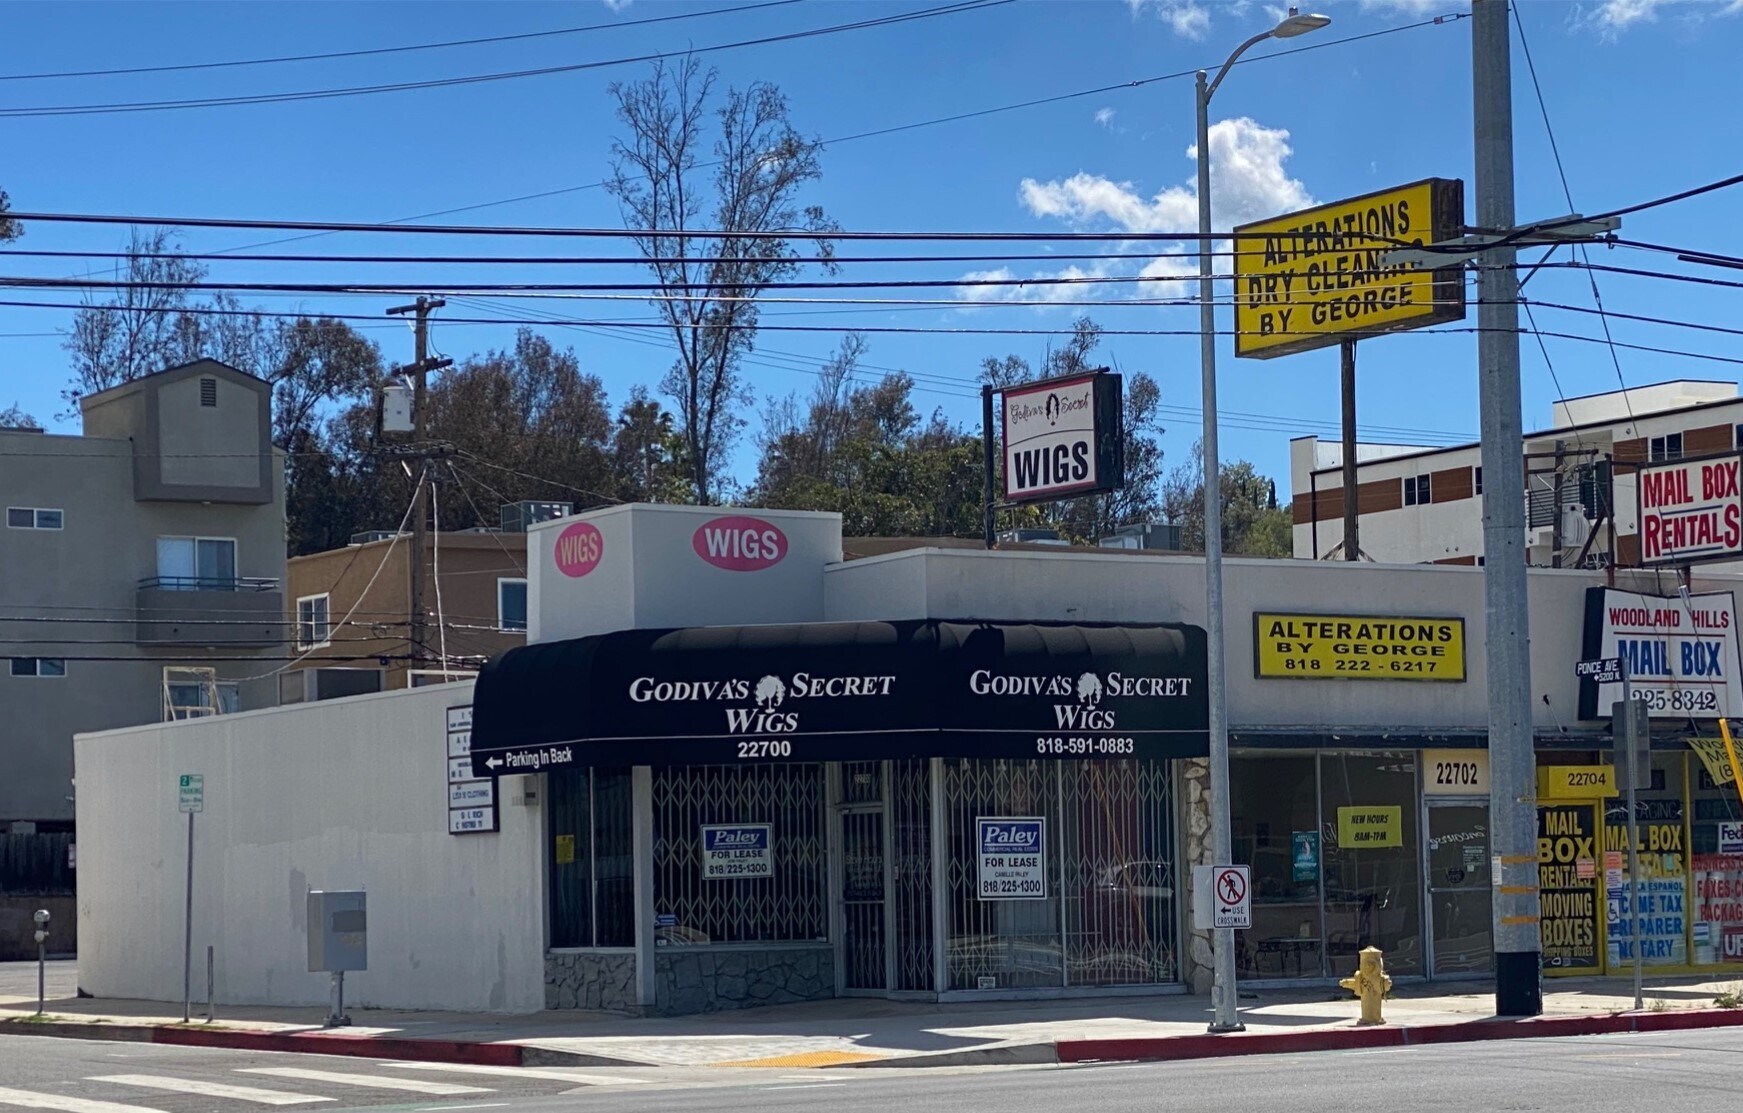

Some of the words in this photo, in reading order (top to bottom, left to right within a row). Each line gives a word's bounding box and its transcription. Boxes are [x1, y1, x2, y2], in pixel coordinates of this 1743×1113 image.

[1264, 201, 1409, 267] ALTERATIONS
[1249, 268, 1294, 309] DRY
[1307, 239, 1423, 296] CLEANI
[1261, 308, 1292, 337] BY
[1311, 282, 1412, 325] GEORGE
[1014, 441, 1088, 489] WIGS
[1643, 469, 1693, 508] MAIL
[1702, 461, 1739, 500] BOX
[1644, 503, 1740, 558] RENTALS
[561, 533, 598, 566] WIGS
[705, 528, 779, 560] WIGS
[1609, 608, 1680, 627] WOODLAND
[1692, 611, 1729, 628] HILLS
[1269, 621, 1452, 642] ALTERATIONS
[1276, 642, 1314, 653] BY
[1332, 643, 1446, 656] GEORGE
[1618, 640, 1672, 675] MAIL
[1681, 642, 1721, 676] BOX
[1285, 658, 1321, 670] 818
[1577, 661, 1602, 674] PONCE
[629, 677, 750, 702] GODIVA'S
[790, 672, 896, 697] SECRET
[969, 670, 1072, 695] GODIVA'S
[1106, 672, 1192, 696] SECRET
[725, 708, 799, 733] WIGS
[1054, 705, 1115, 729] WIGS
[737, 741, 791, 757] 22700
[1037, 738, 1134, 754] 818-591-0883
[506, 750, 540, 769] Parking
[540, 749, 549, 765] In
[550, 746, 572, 763] Back
[181, 775, 189, 786] 2
[1436, 762, 1478, 784] 22702
[1567, 773, 1607, 786] 22704
[1351, 815, 1366, 824] NEW
[1367, 814, 1389, 824] HOURS
[1545, 811, 1582, 835] MAIL
[714, 830, 760, 845] Paley
[984, 826, 1037, 846] Paley
[1605, 825, 1645, 851] MAL
[1649, 825, 1681, 850] BOX
[711, 851, 730, 859] FOR
[734, 850, 763, 858] LEASE
[1537, 837, 1593, 863] BOX
[985, 858, 1004, 868] FOR
[1008, 857, 1038, 867] LEASE
[1540, 866, 1592, 888] RENTA
[1232, 906, 1244, 914] USE
[1541, 894, 1592, 918] MOVING
[1660, 895, 1683, 912] TAX
[1217, 916, 1248, 925] CROSSWALK
[1543, 918, 1593, 946] BOXES
